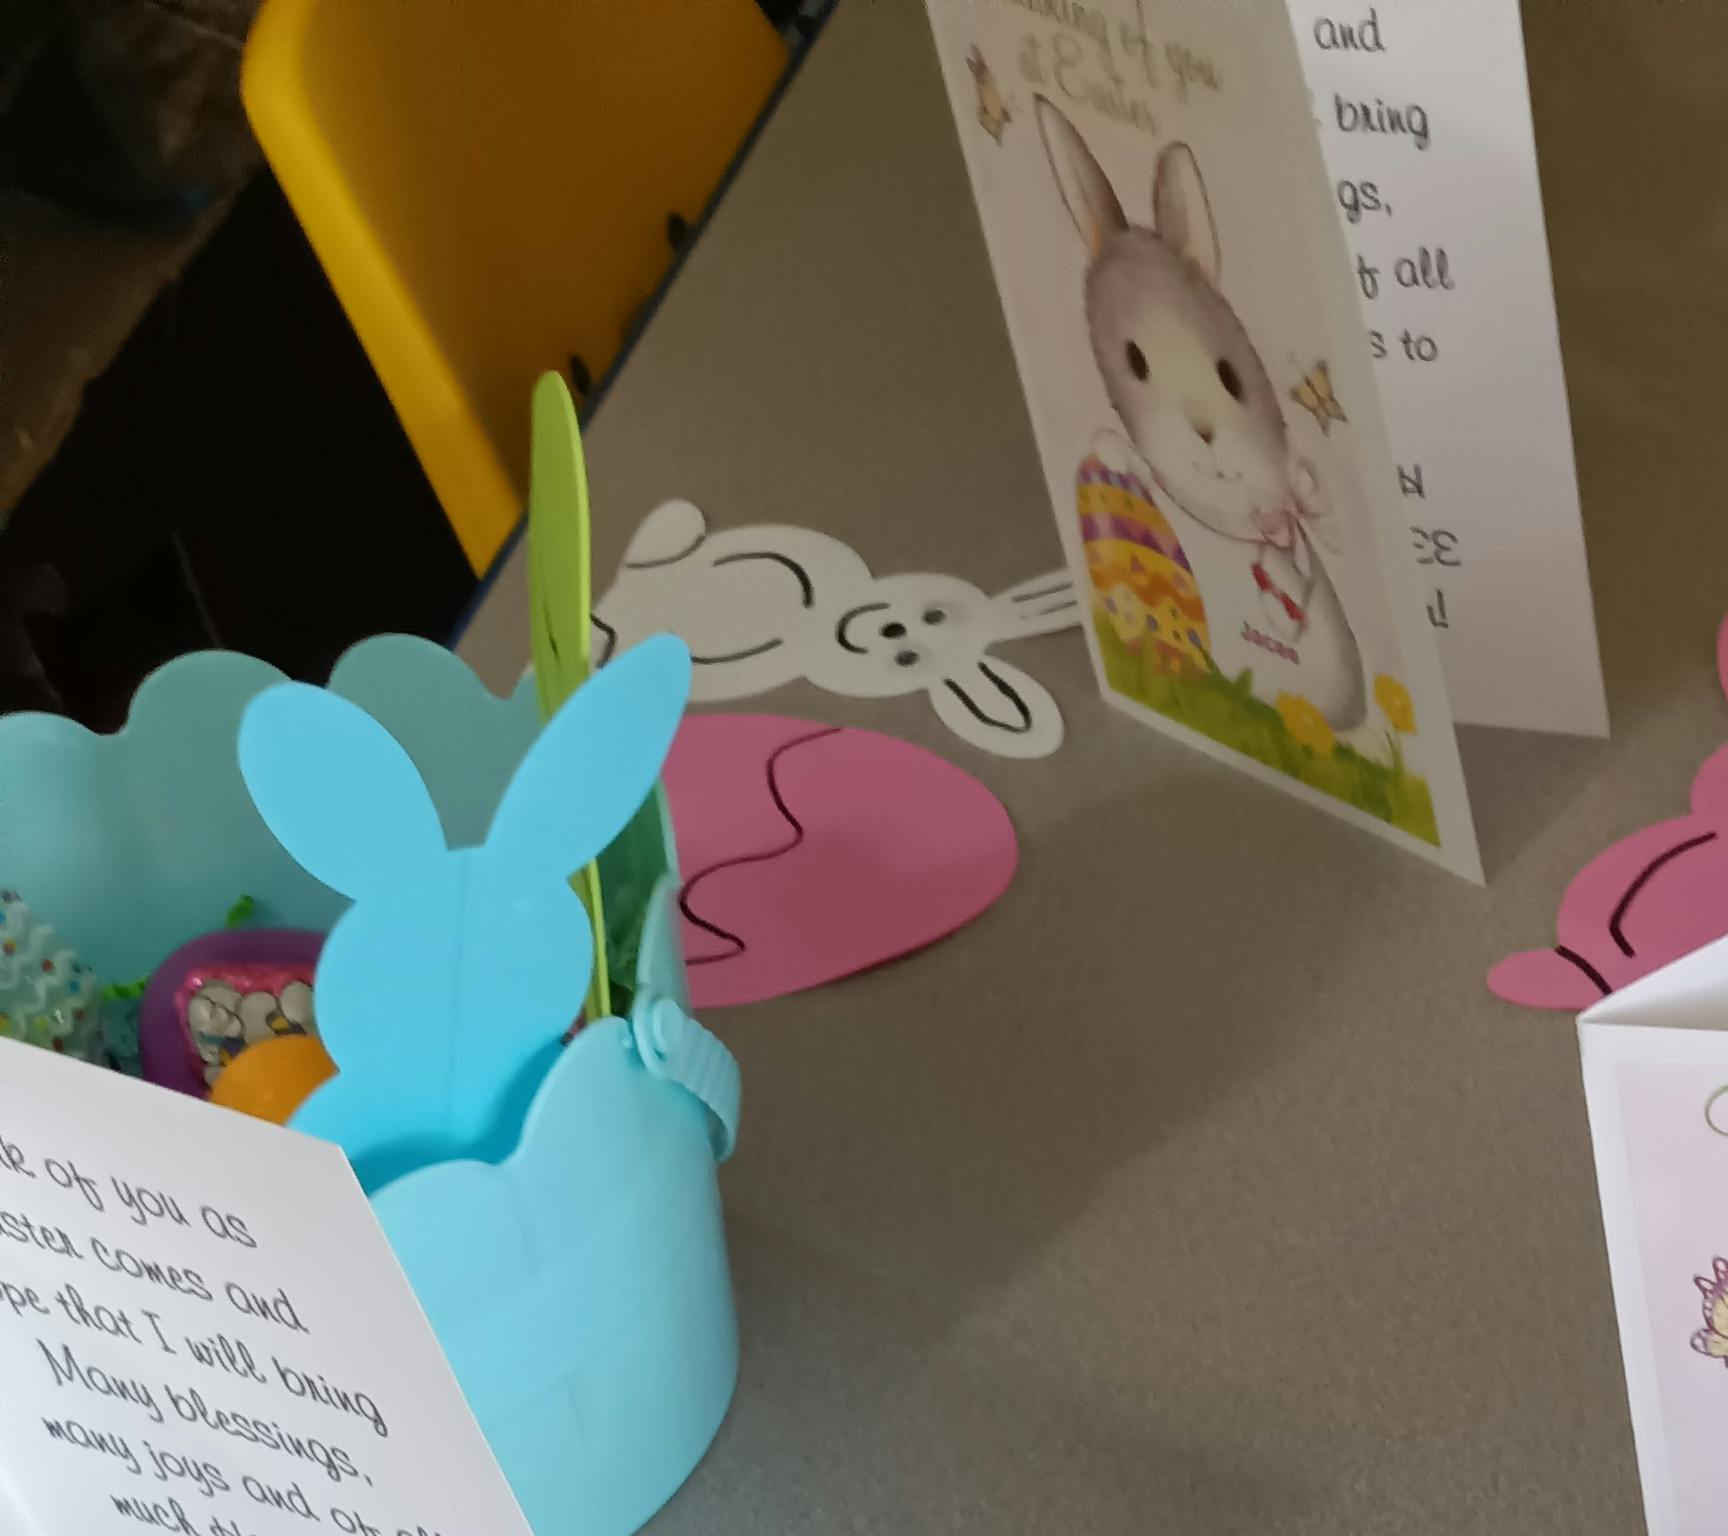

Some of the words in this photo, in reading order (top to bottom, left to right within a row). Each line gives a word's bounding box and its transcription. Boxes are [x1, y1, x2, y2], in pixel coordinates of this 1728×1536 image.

[1313, 7, 1387, 52] and
[1334, 93, 1431, 151] bring
[1394, 246, 1456, 291] all
[1398, 328, 1439, 362] to
[45, 1158, 104, 1212] of
[111, 1176, 191, 1227] you
[201, 1205, 257, 1249] as
[90, 1237, 213, 1302] comes
[225, 1282, 310, 1334] and
[55, 1284, 143, 1344] that
[141, 1308, 177, 1355] I
[184, 1333, 267, 1384] will
[272, 1356, 388, 1437] bring
[37, 1338, 163, 1423] Many
[164, 1385, 374, 1487] blessings,
[42, 1417, 141, 1475] many
[143, 1441, 231, 1497] joys
[242, 1475, 320, 1522] and
